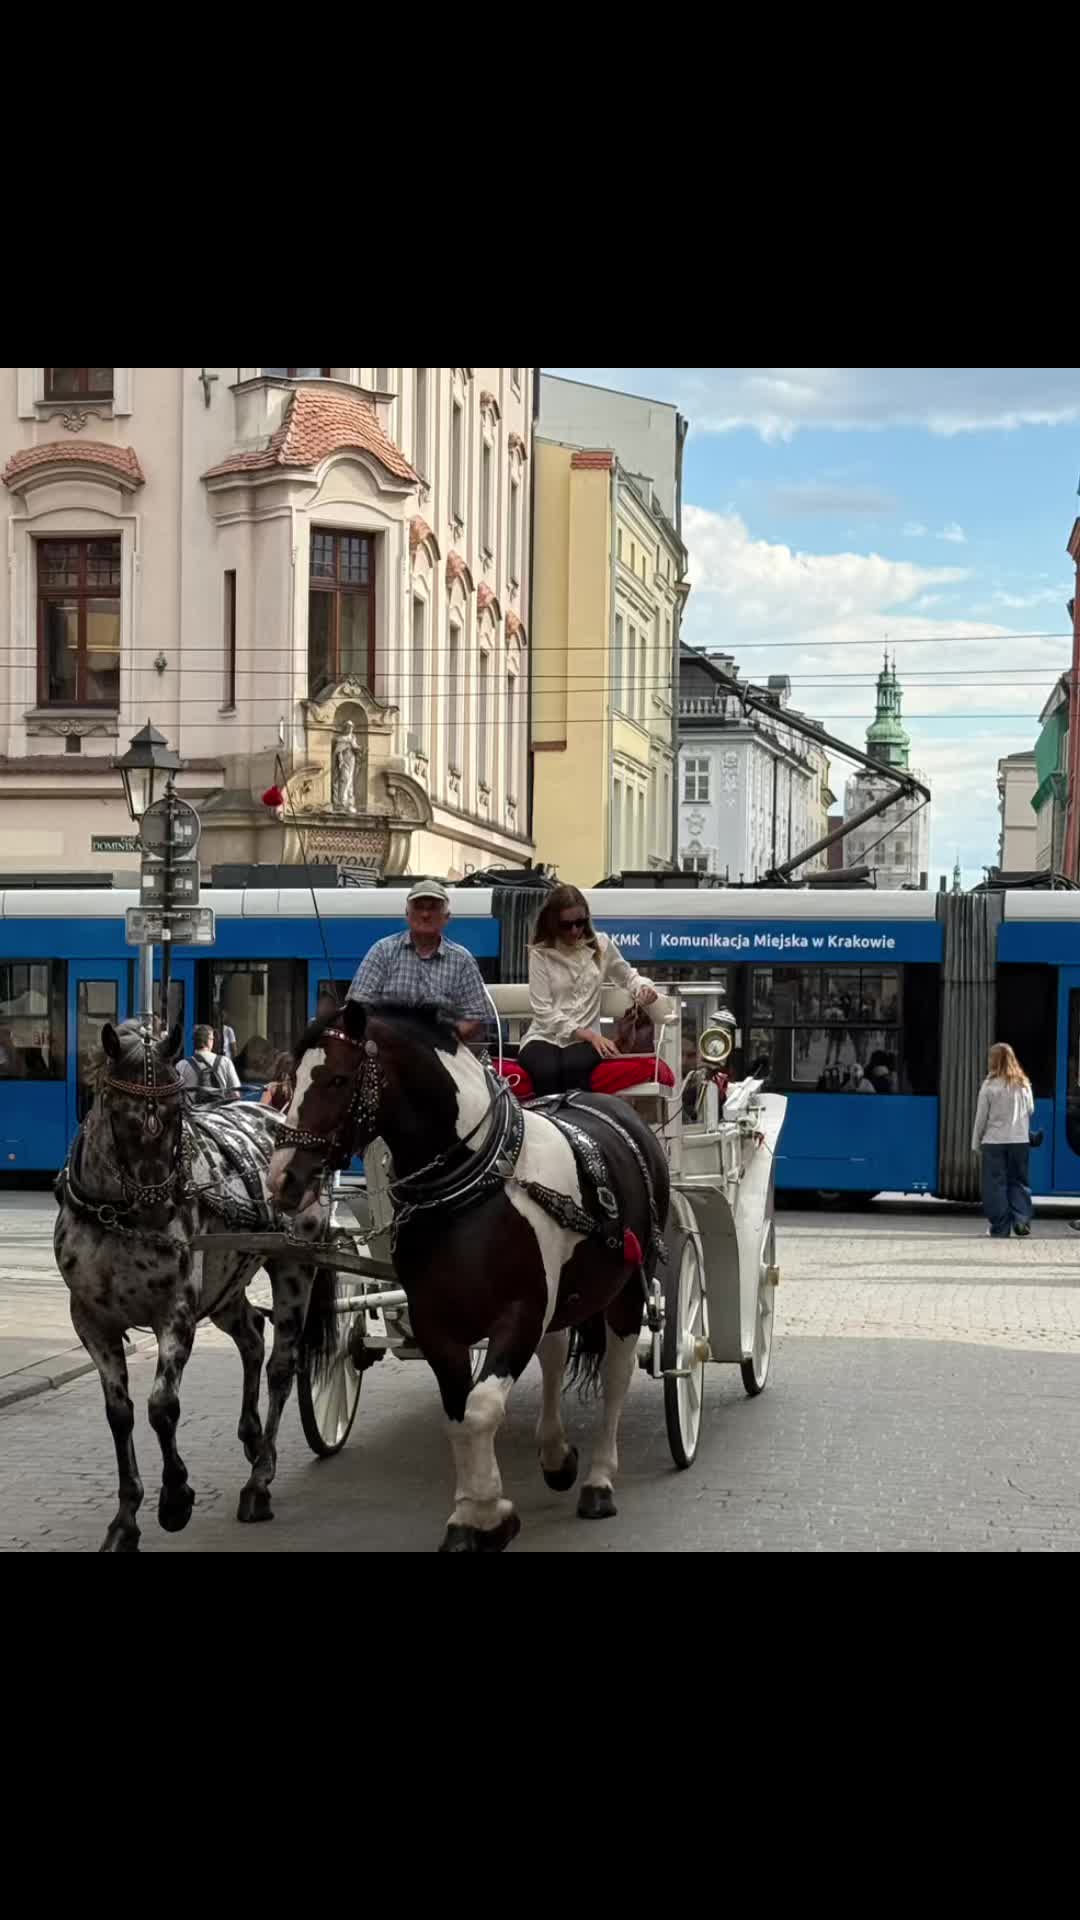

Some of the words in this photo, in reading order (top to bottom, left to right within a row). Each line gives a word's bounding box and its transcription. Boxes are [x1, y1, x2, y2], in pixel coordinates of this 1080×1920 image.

[93, 841, 144, 850] DOMINIKA
[610, 933, 640, 946] KMK
[660, 933, 750, 950] Komunikacja
[753, 933, 808, 950] Miejska
[812, 937, 824, 947] w
[828, 934, 896, 949] Krakowie
